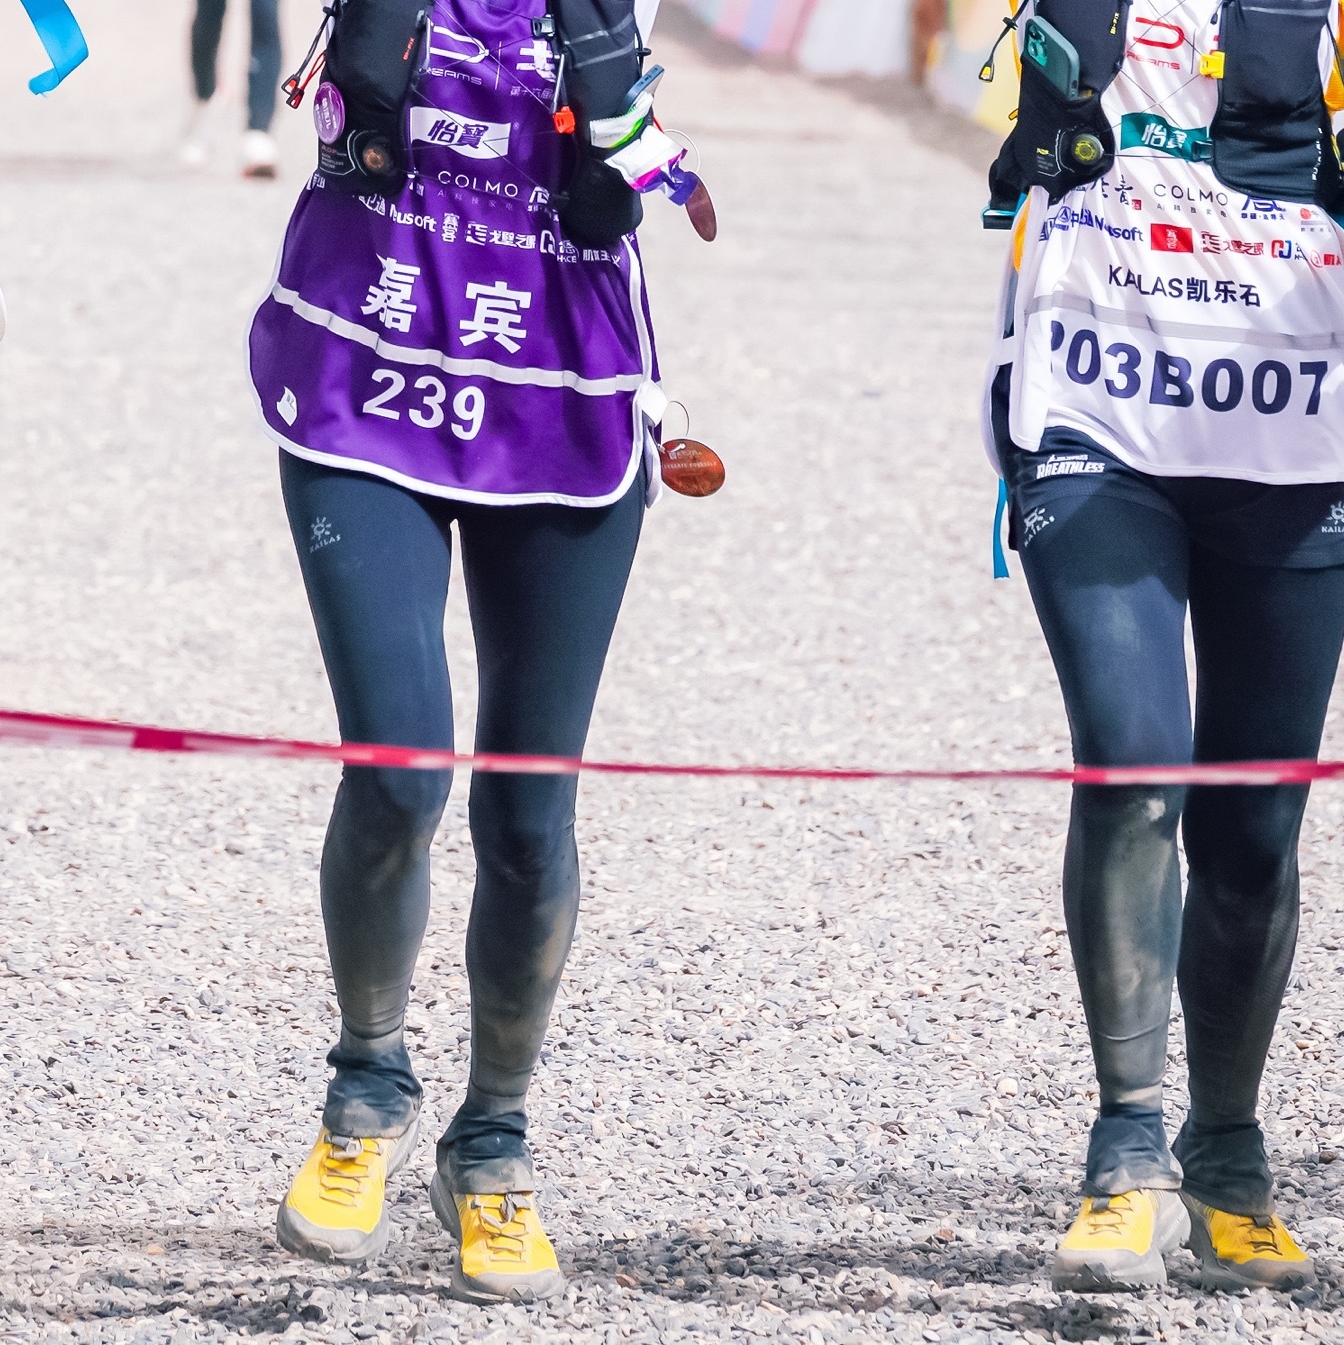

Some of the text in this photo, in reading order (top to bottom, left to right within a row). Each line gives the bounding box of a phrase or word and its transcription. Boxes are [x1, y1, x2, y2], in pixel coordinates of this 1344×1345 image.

[428, 119, 489, 149] 怡寶
[438, 171, 518, 197] COLMO
[1154, 184, 1228, 206] COLMO
[360, 253, 532, 354] 嘉宾
[362, 368, 486, 441] 239
[309, 534, 341, 554] KAILAS
